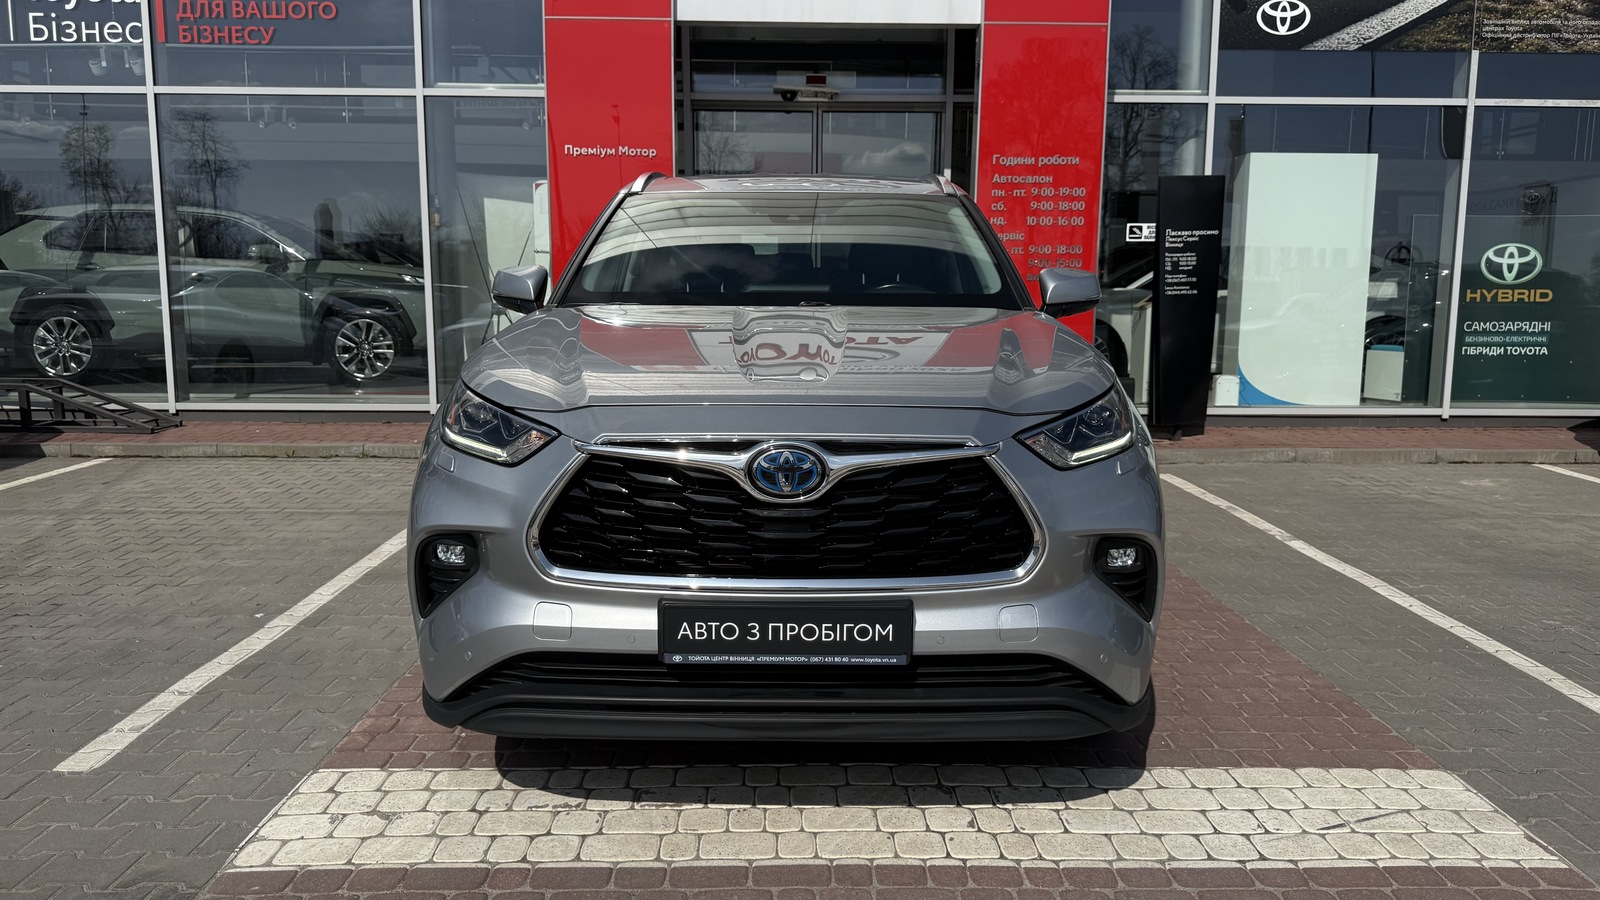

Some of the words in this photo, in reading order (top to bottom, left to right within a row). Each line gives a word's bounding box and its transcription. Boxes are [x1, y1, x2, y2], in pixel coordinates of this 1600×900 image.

[176, 0, 225, 21] ДЛЯ
[231, 0, 337, 20] ВАШОГО
[28, 12, 143, 44] Бізнес
[178, 25, 275, 44] БІЗНЕСУ
[564, 144, 616, 158] Преміум
[618, 146, 657, 159] Мотор
[992, 154, 1035, 167] Години
[1038, 154, 1080, 168] роботи
[992, 173, 1053, 184] Автосалон
[1031, 187, 1086, 197] 9:00-19:00
[991, 201, 1007, 211] сб.
[1030, 201, 1085, 211] 9:00-18:00
[990, 216, 1007, 226] нд.
[1026, 216, 1085, 226] 10:00-16:00
[997, 231, 1025, 242] ервіс
[1028, 245, 1083, 255] 9:00-18:00
[1465, 289, 1553, 303] HYBRID
[1463, 321, 1551, 333] САМОЗАРЯДНІ
[1462, 346, 1504, 357] ГІБРИДИ
[1506, 346, 1548, 355] TOYOTA
[677, 621, 739, 640] АВТО
[746, 622, 760, 641] З
[768, 623, 893, 642] ПРОБІГОМ
